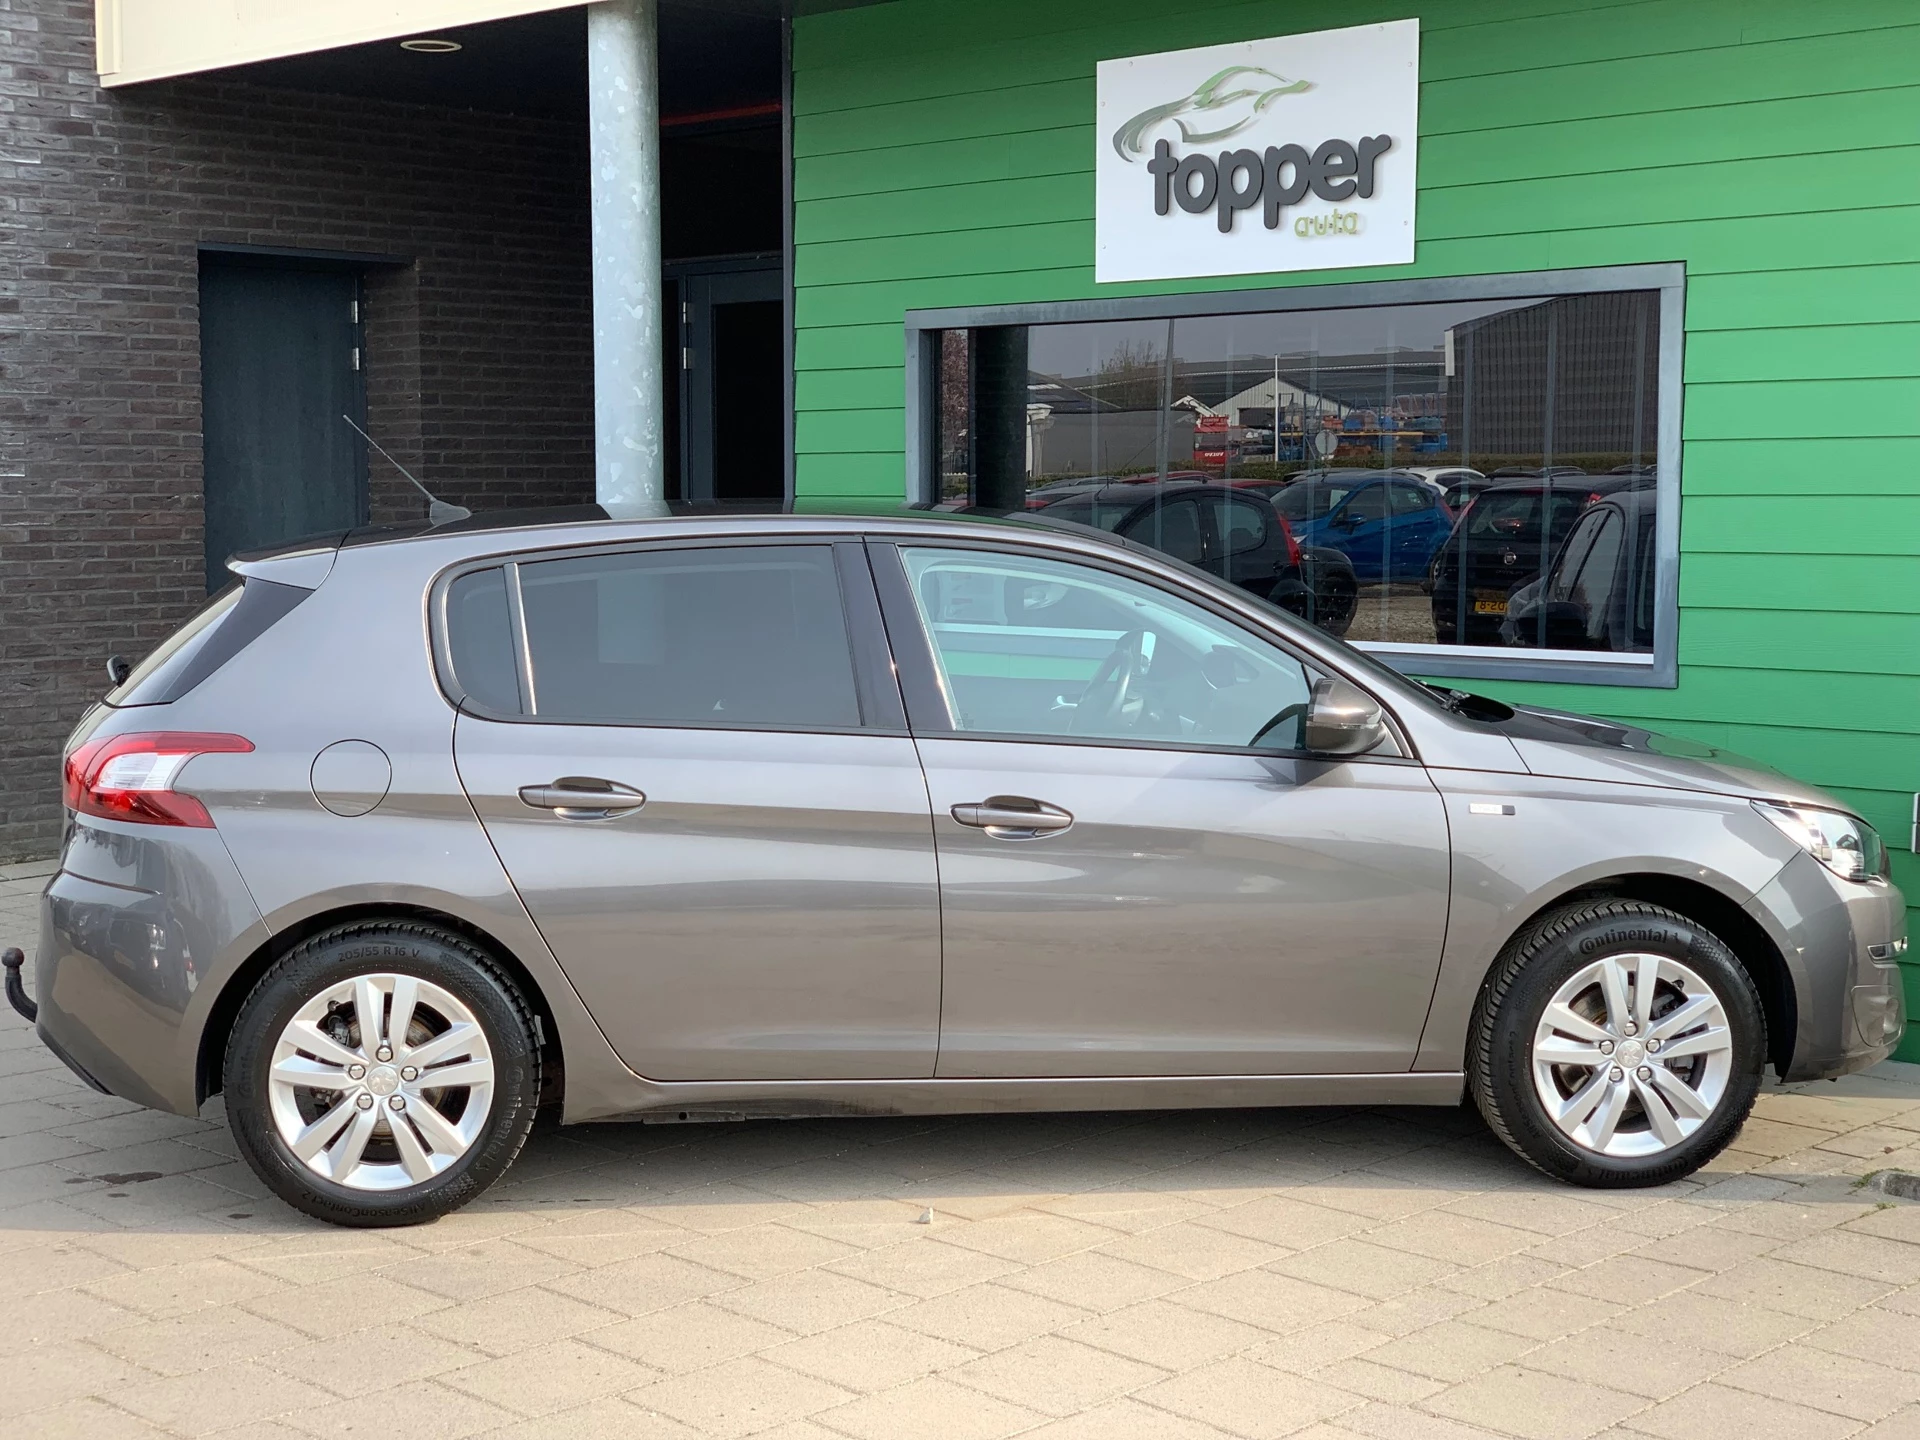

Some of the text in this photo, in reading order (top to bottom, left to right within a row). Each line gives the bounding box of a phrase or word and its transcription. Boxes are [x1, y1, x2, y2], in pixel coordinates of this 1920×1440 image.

[1147, 133, 1392, 233] topper
[1294, 208, 1358, 237] auto
[338, 946, 420, 962] 205/55 R 16 V
[1578, 928, 1668, 954] Continental
